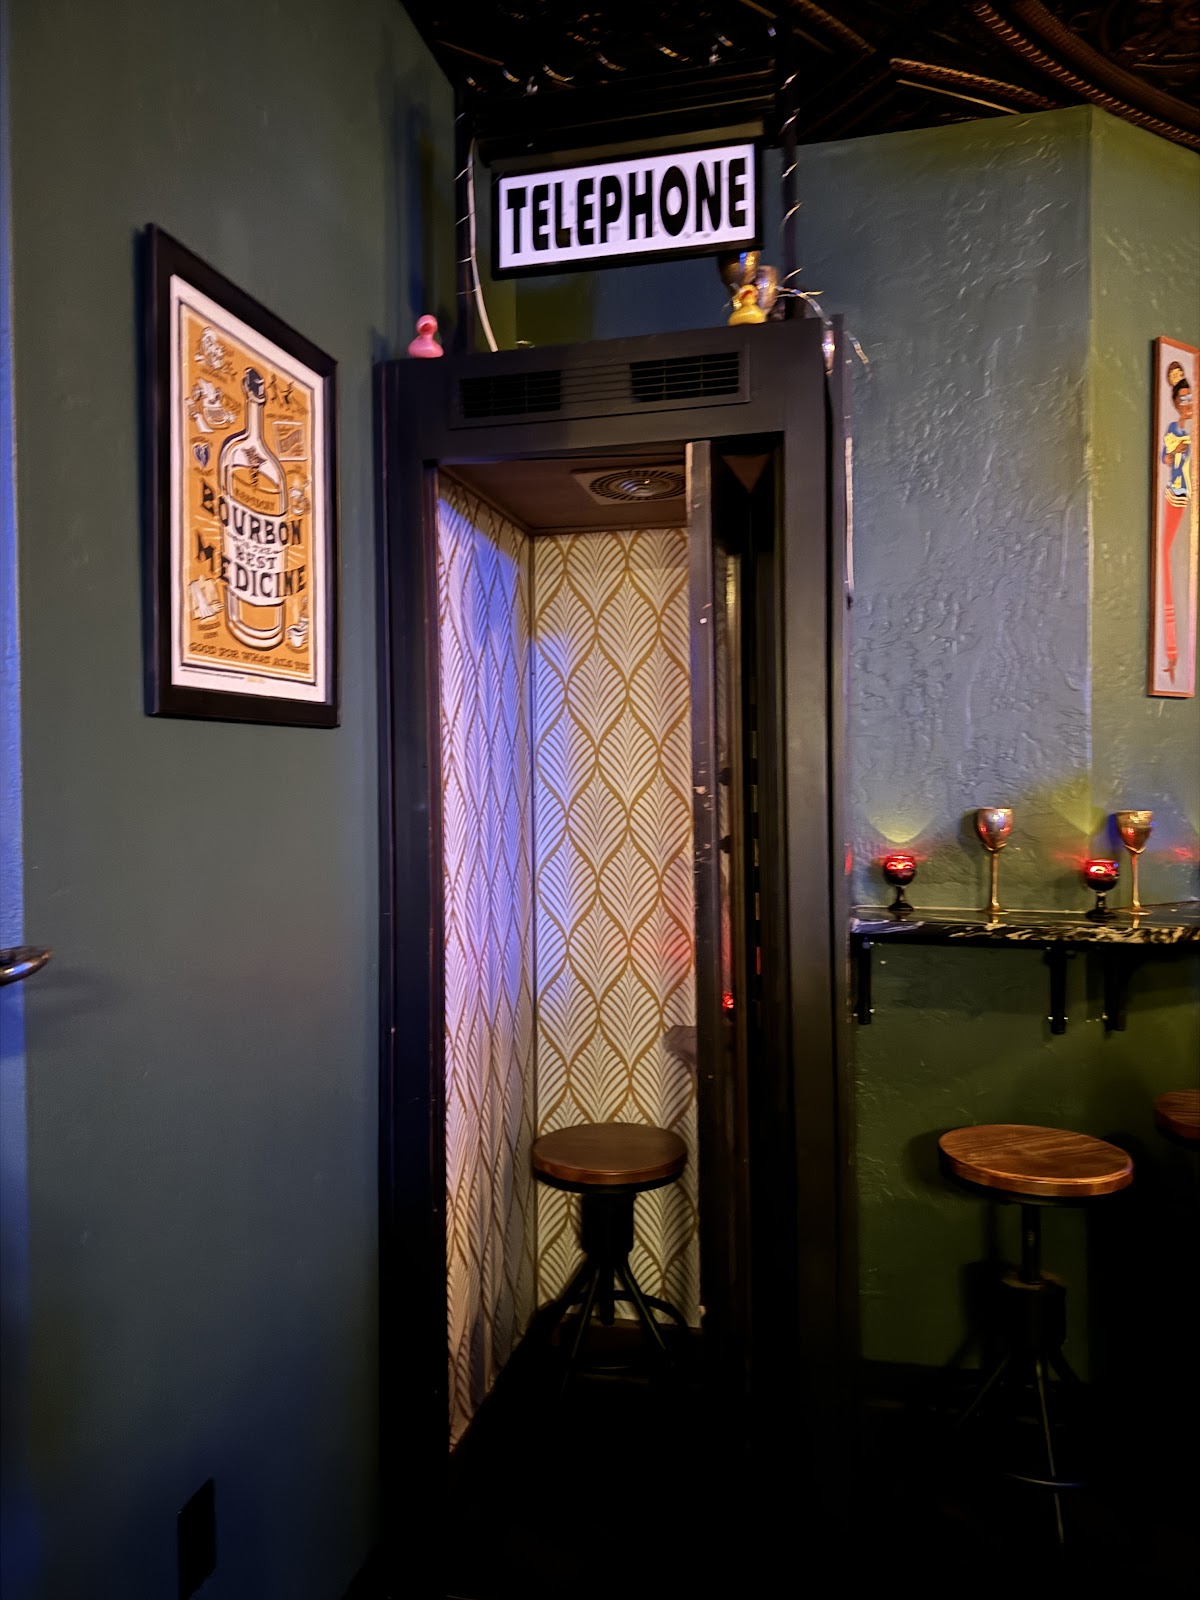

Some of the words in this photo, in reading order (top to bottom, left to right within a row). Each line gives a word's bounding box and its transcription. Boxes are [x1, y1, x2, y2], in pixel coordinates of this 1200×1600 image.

[506, 156, 748, 255] TELEPHONE
[201, 483, 302, 547] BOURBON
[197, 529, 307, 598] MEDICINE
[234, 543, 277, 570] BEST
[188, 641, 217, 655] GOOD
